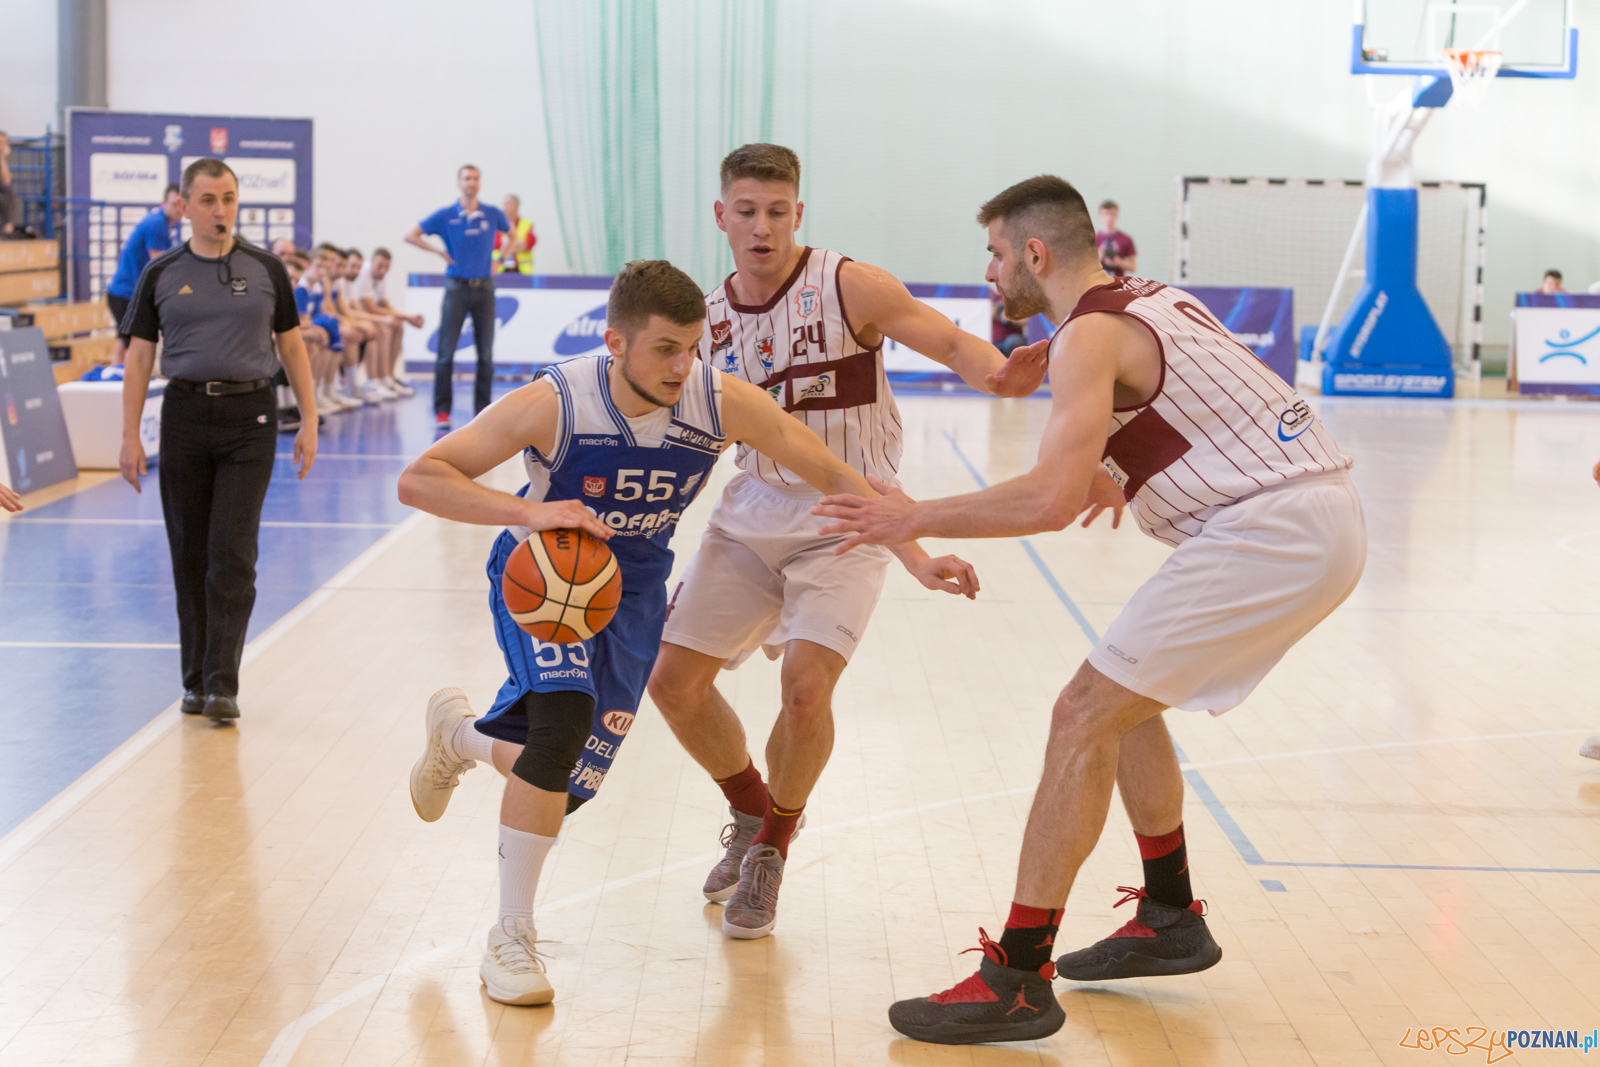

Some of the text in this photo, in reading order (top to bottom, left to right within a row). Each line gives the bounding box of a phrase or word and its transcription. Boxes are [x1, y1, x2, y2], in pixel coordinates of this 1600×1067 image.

[566, 315, 608, 338] atre
[792, 320, 826, 357] 24
[1334, 373, 1447, 386] SPORT SYSTEM
[578, 437, 618, 447] macron
[681, 429, 713, 448] CAPTAIN
[614, 469, 677, 502] 55
[531, 636, 589, 668] 55
[540, 668, 587, 680] macron
